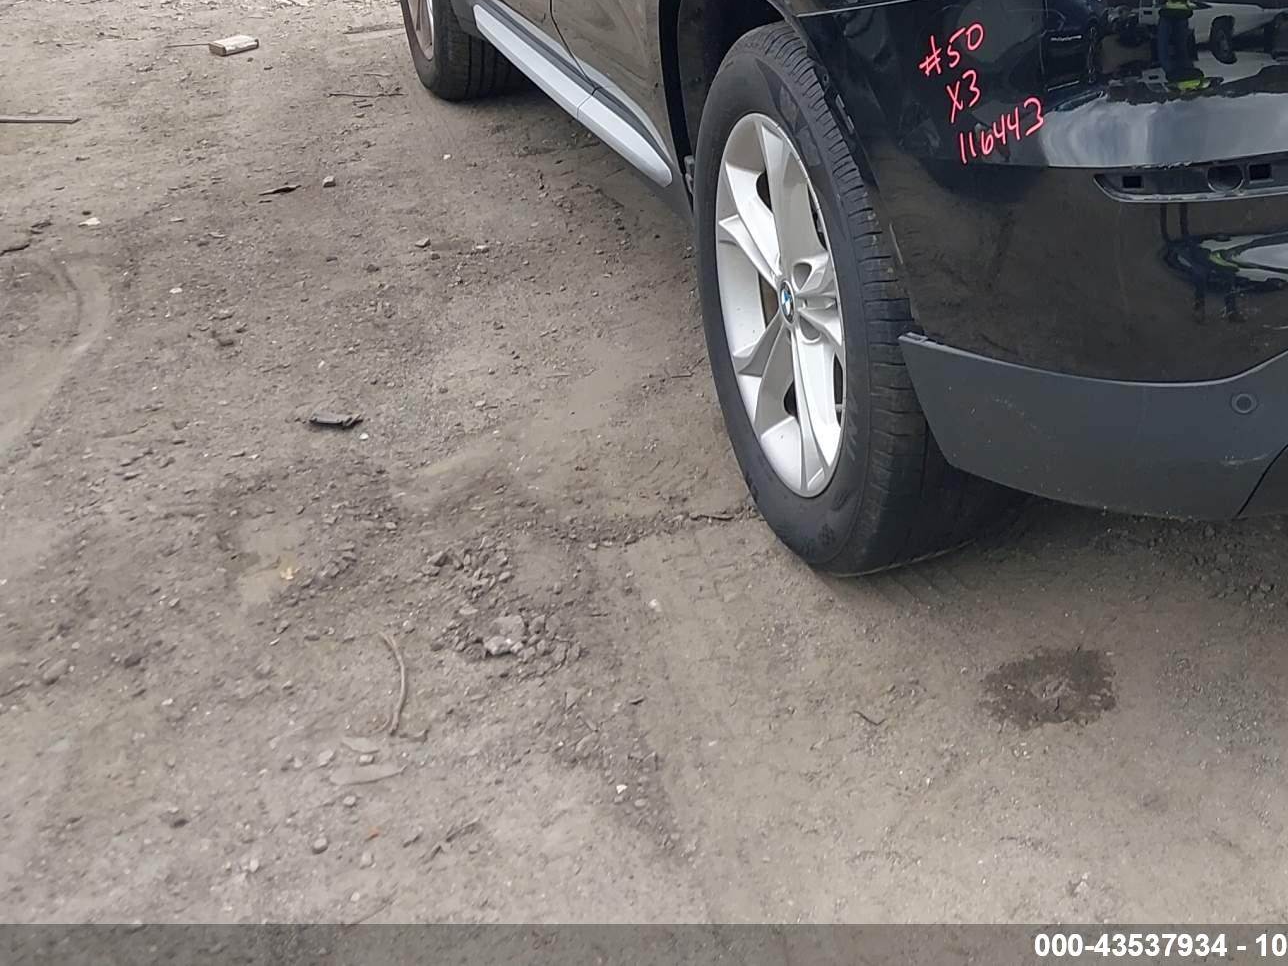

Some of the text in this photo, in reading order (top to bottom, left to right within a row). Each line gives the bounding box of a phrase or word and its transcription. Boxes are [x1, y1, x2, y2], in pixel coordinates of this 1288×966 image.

[919, 23, 985, 77] #50
[946, 69, 981, 124] X3
[959, 97, 1044, 164] 116443
